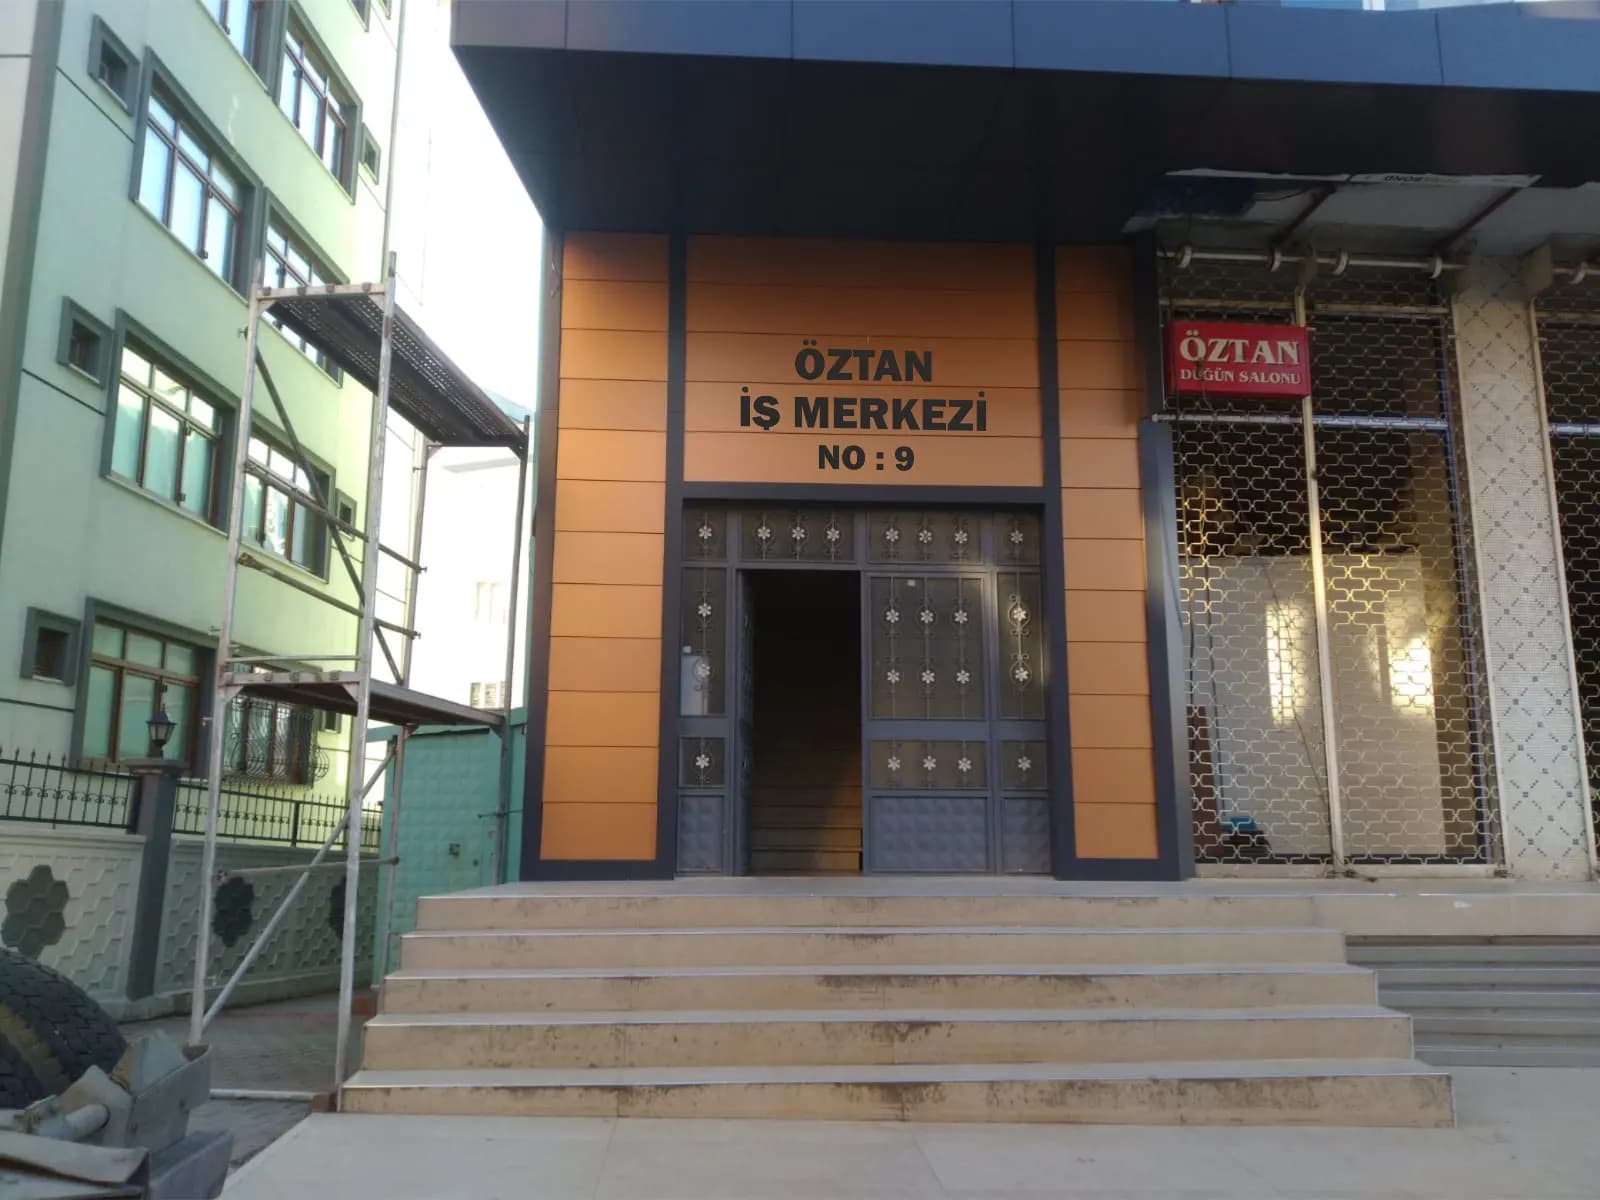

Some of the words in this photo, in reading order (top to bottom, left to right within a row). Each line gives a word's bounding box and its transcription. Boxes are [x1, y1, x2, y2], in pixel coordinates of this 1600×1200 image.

[795, 339, 932, 381] ÖZTAN
[1179, 330, 1299, 364] ÖZTAN
[1239, 370, 1301, 385] SALONU
[740, 386, 780, 430] İŞ
[794, 391, 987, 431] MERKEZİ
